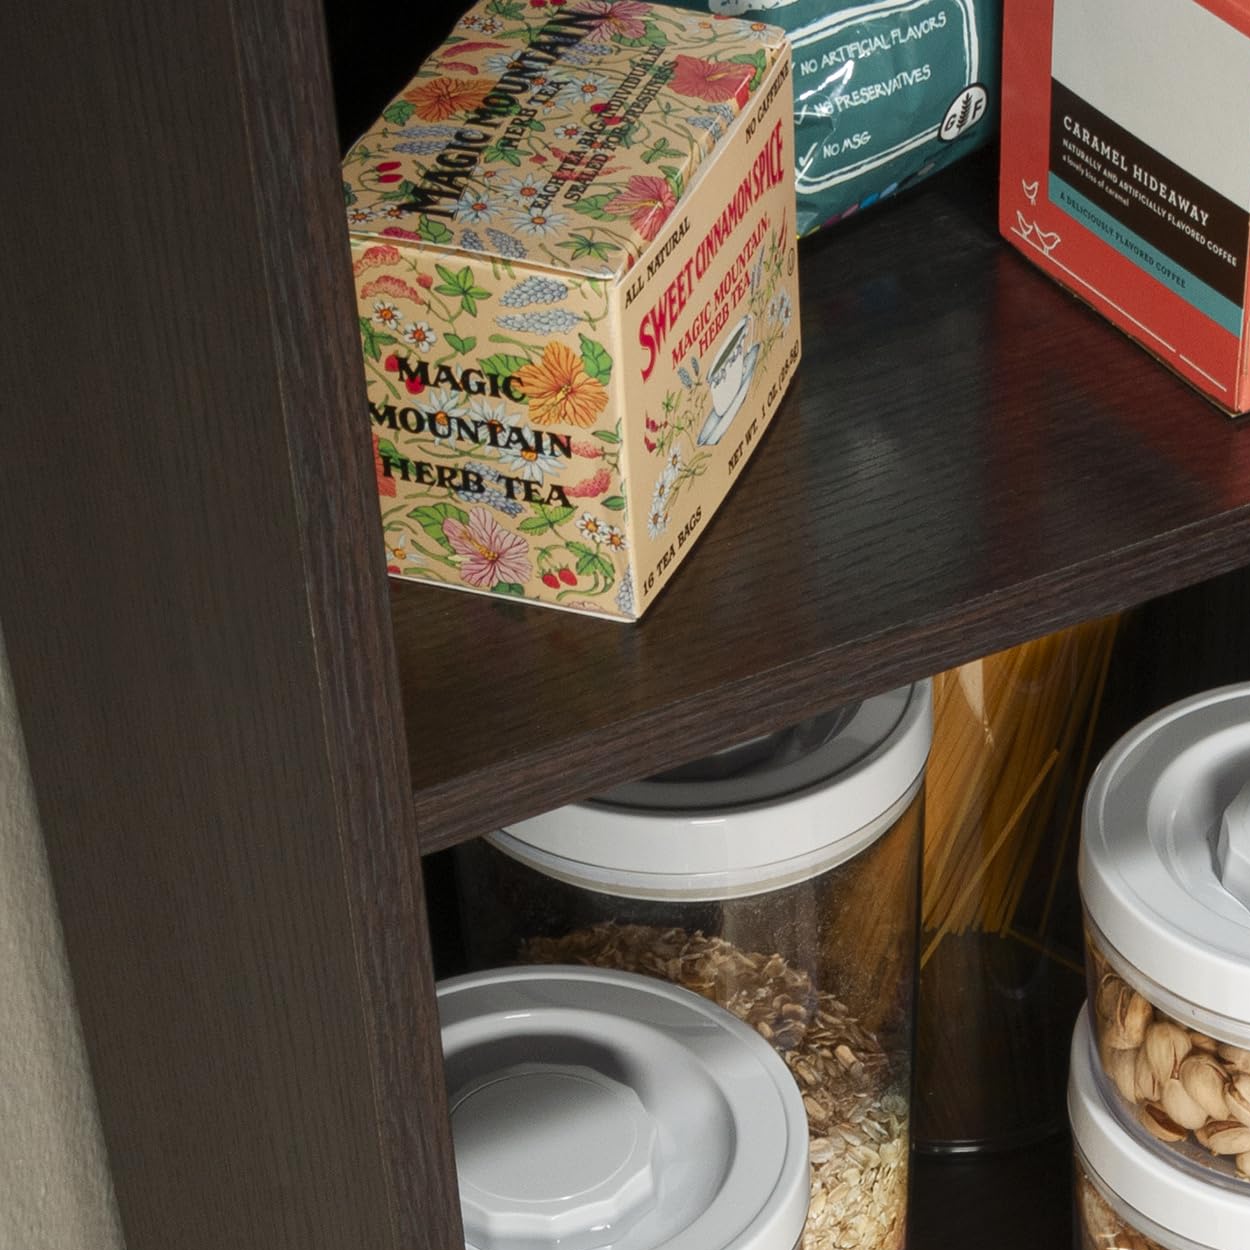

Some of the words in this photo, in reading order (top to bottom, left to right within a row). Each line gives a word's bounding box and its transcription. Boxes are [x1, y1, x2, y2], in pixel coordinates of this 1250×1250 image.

[801, 60, 817, 75] NO
[821, 37, 891, 68] ARTIFICIAL
[891, 12, 947, 45] FLAVORS
[398, 128, 493, 221] MAGIC
[464, 9, 605, 129] MOUNTAIN
[502, 107, 538, 152] HERB
[528, 80, 571, 106] TEA
[531, 175, 566, 209] EACH
[556, 149, 587, 174] TEA
[577, 120, 606, 149] BAG
[599, 44, 665, 122] INDIVIDUALLY
[745, 121, 756, 144] NO
[757, 59, 789, 124] CAFFEINE
[836, 65, 932, 114] PRESERVATIVES
[564, 152, 609, 201] SEALED
[604, 124, 631, 151] FOR
[823, 141, 840, 159] NO
[842, 131, 872, 153] MSG
[1063, 115, 1128, 172] CARAMEL
[1133, 163, 1209, 226] HIDEAWAY
[1067, 155, 1085, 176] lovely
[1085, 168, 1098, 185] kiss
[1105, 187, 1130, 208] caramel
[1062, 138, 1102, 172] NATURALLY
[1103, 167, 1118, 185] AND
[1118, 178, 1166, 218] ARTIFICIALLY
[1167, 212, 1206, 245] FLAVORED
[1206, 240, 1238, 267] COFFEE
[1066, 195, 1115, 236] DELICIOUSLY
[1115, 231, 1154, 266] FLAVORED
[1155, 261, 1186, 288] COFFEE
[624, 274, 645, 309] ALL
[646, 216, 691, 282] NATURAL
[638, 257, 694, 384] SWEET
[695, 170, 754, 280] CINNAMON
[752, 117, 784, 203] SPICE
[671, 301, 710, 369] MAGIC
[713, 213, 770, 311] MOUNTAIN
[699, 303, 730, 358] HERB
[731, 270, 751, 308] TEA
[397, 355, 526, 402] MAGIC
[368, 402, 572, 459] MOUNTAIN
[728, 440, 744, 475] NET
[380, 455, 486, 493] HERB
[497, 475, 577, 508] TEA
[642, 572, 655, 596] 16
[656, 544, 676, 576] TEA
[677, 506, 702, 549] BAGS
